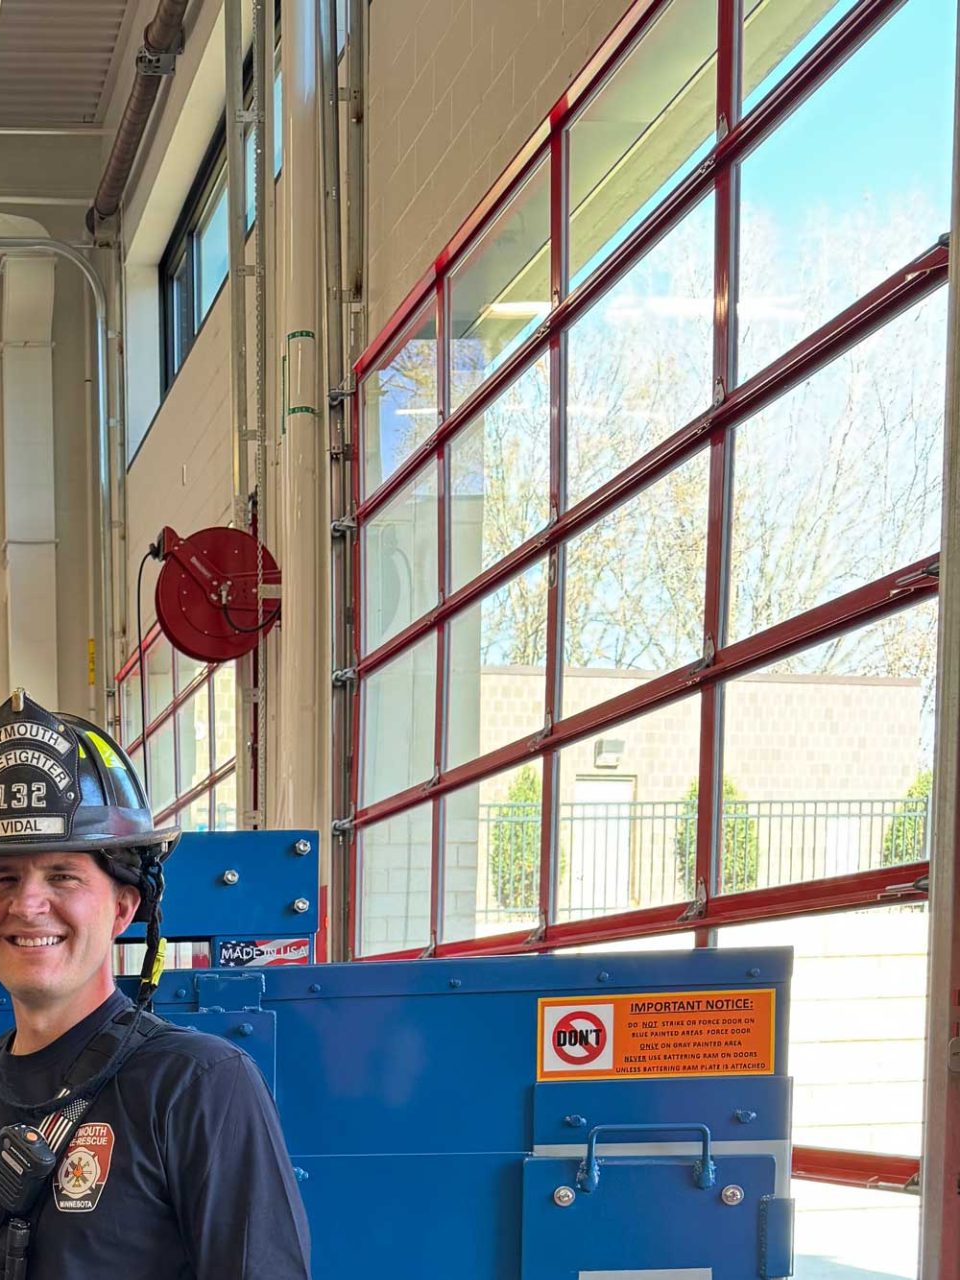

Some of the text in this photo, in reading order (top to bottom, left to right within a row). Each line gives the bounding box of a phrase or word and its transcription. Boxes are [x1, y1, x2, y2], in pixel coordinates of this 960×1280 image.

[1, 819, 42, 835] VIDAL
[221, 946, 261, 959] MADE
[281, 946, 306, 955] USA
[630, 999, 753, 1013] IMPORTANT NOTICE:
[557, 1029, 602, 1047] DON'T
[60, 1200, 93, 1208] MINNESOTA
